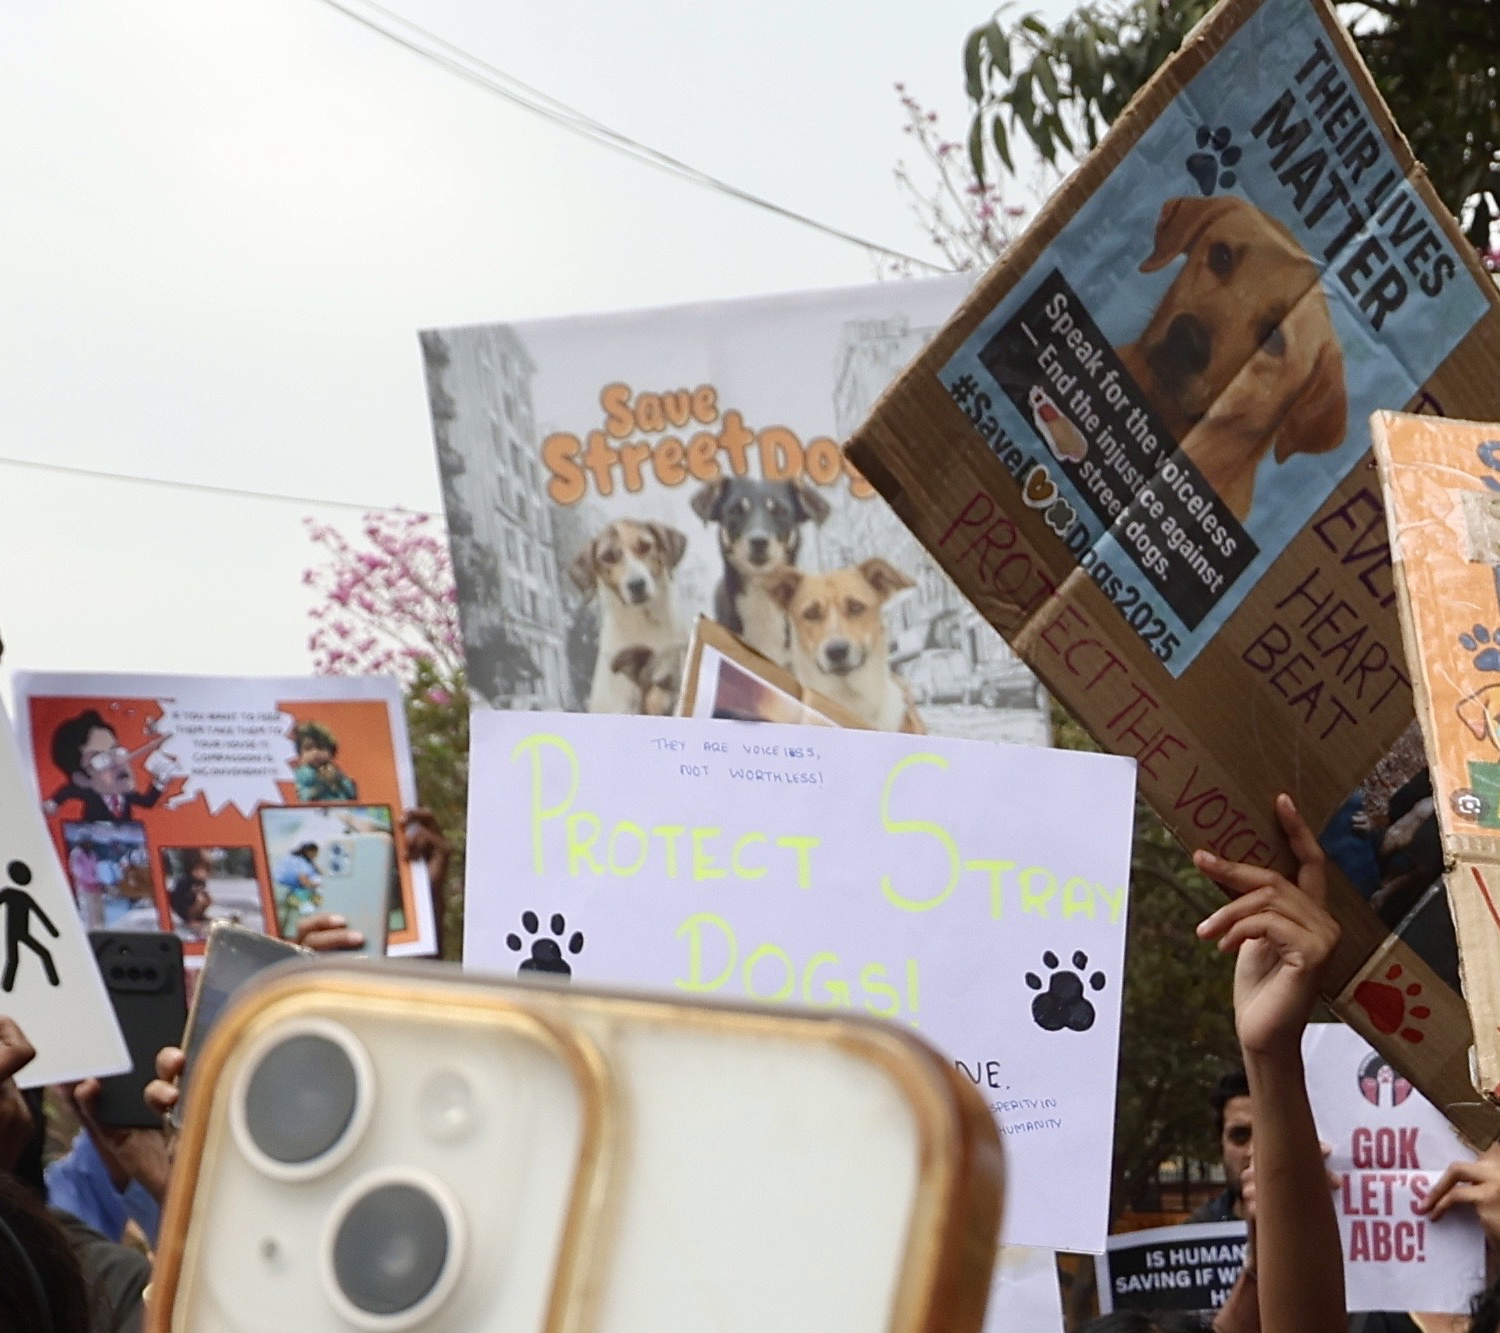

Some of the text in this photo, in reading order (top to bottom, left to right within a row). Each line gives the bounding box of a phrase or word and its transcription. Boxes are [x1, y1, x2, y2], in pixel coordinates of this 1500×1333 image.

[1251, 90, 1409, 331] MATTER
[1295, 38, 1386, 180] THEIR
[1385, 163, 1456, 300] LIVES
[542, 409, 754, 504] Street
[601, 382, 720, 438] Save
[1046, 292, 1239, 558] Speak for the voiceless
[1037, 345, 1225, 594] End the injustice against
[1079, 460, 1170, 580] street dogs.
[938, 491, 1128, 690] PROTECT
[1107, 683, 1188, 782] THE
[1242, 621, 1358, 741] BEAT
[1276, 567, 1412, 714] HEART
[651, 737, 685, 751] THEY
[704, 741, 728, 753] ARE
[680, 764, 824, 789] NOT WORTHLESS!
[511, 733, 1128, 924] PROTECT STRAY
[675, 912, 920, 1029] DOGS!
[1341, 1172, 1430, 1217] LET'S
[1352, 1126, 1420, 1170] GOK
[1115, 1270, 1192, 1294] SAVING
[1195, 1267, 1215, 1286] IF
[1145, 1250, 1166, 1269] IS
[1350, 1219, 1426, 1262] ABC!
